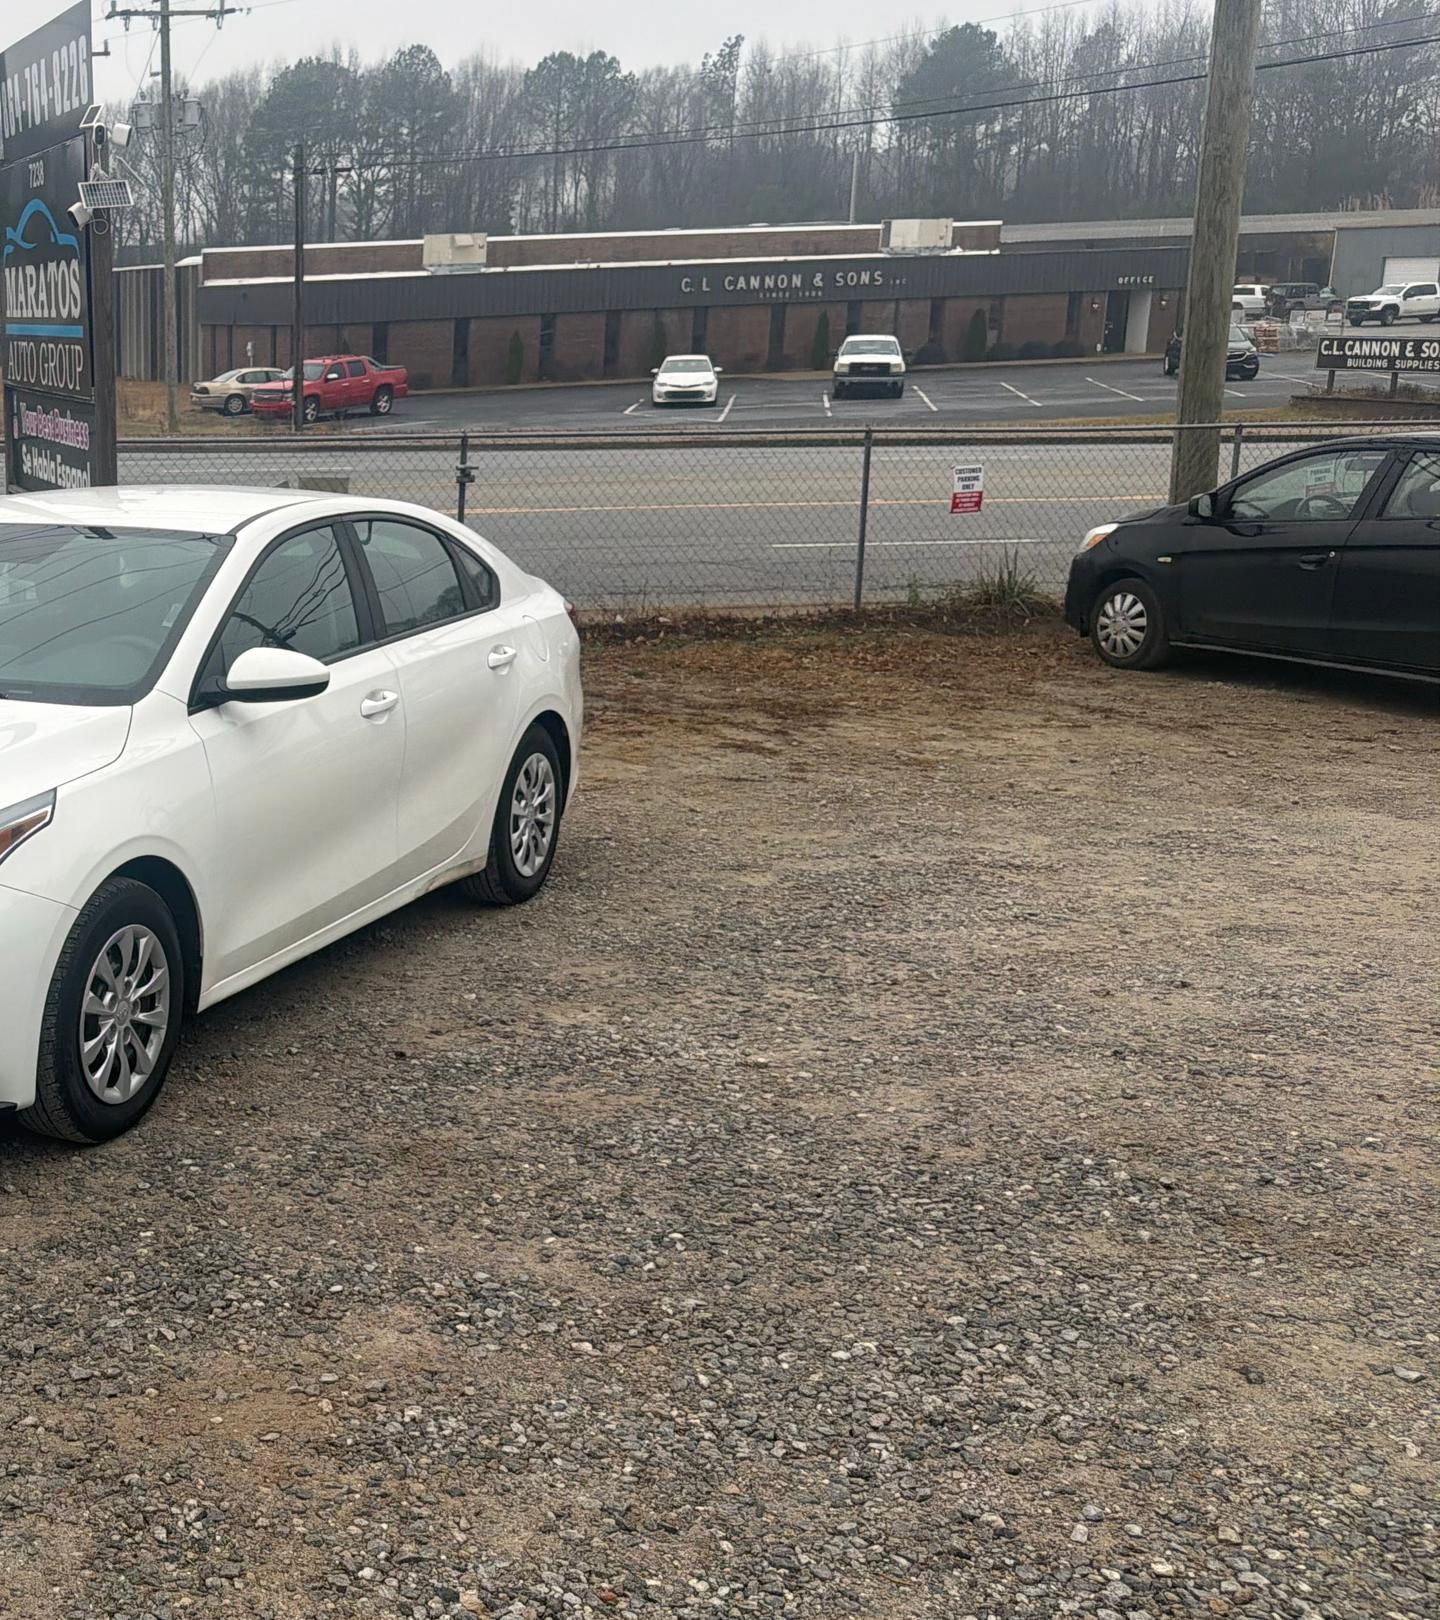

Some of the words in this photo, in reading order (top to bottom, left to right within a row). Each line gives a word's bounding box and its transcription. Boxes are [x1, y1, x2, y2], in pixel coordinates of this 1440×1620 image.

[1, 34, 89, 139] 864-764-8226
[4, 259, 82, 320] MARATOS
[724, 273, 802, 291] CANNON
[812, 272, 824, 287] &
[835, 270, 884, 287] SONS
[1118, 275, 1154, 284] OFFICE
[1346, 358, 1389, 368] BUILDING
[1394, 360, 1440, 370] SUPPLIES
[1420, 341, 1440, 358] SO
[8, 340, 38, 384] AUTO
[40, 342, 84, 391] GROUP
[22, 443, 33, 476] Se
[32, 446, 56, 484] Habla
